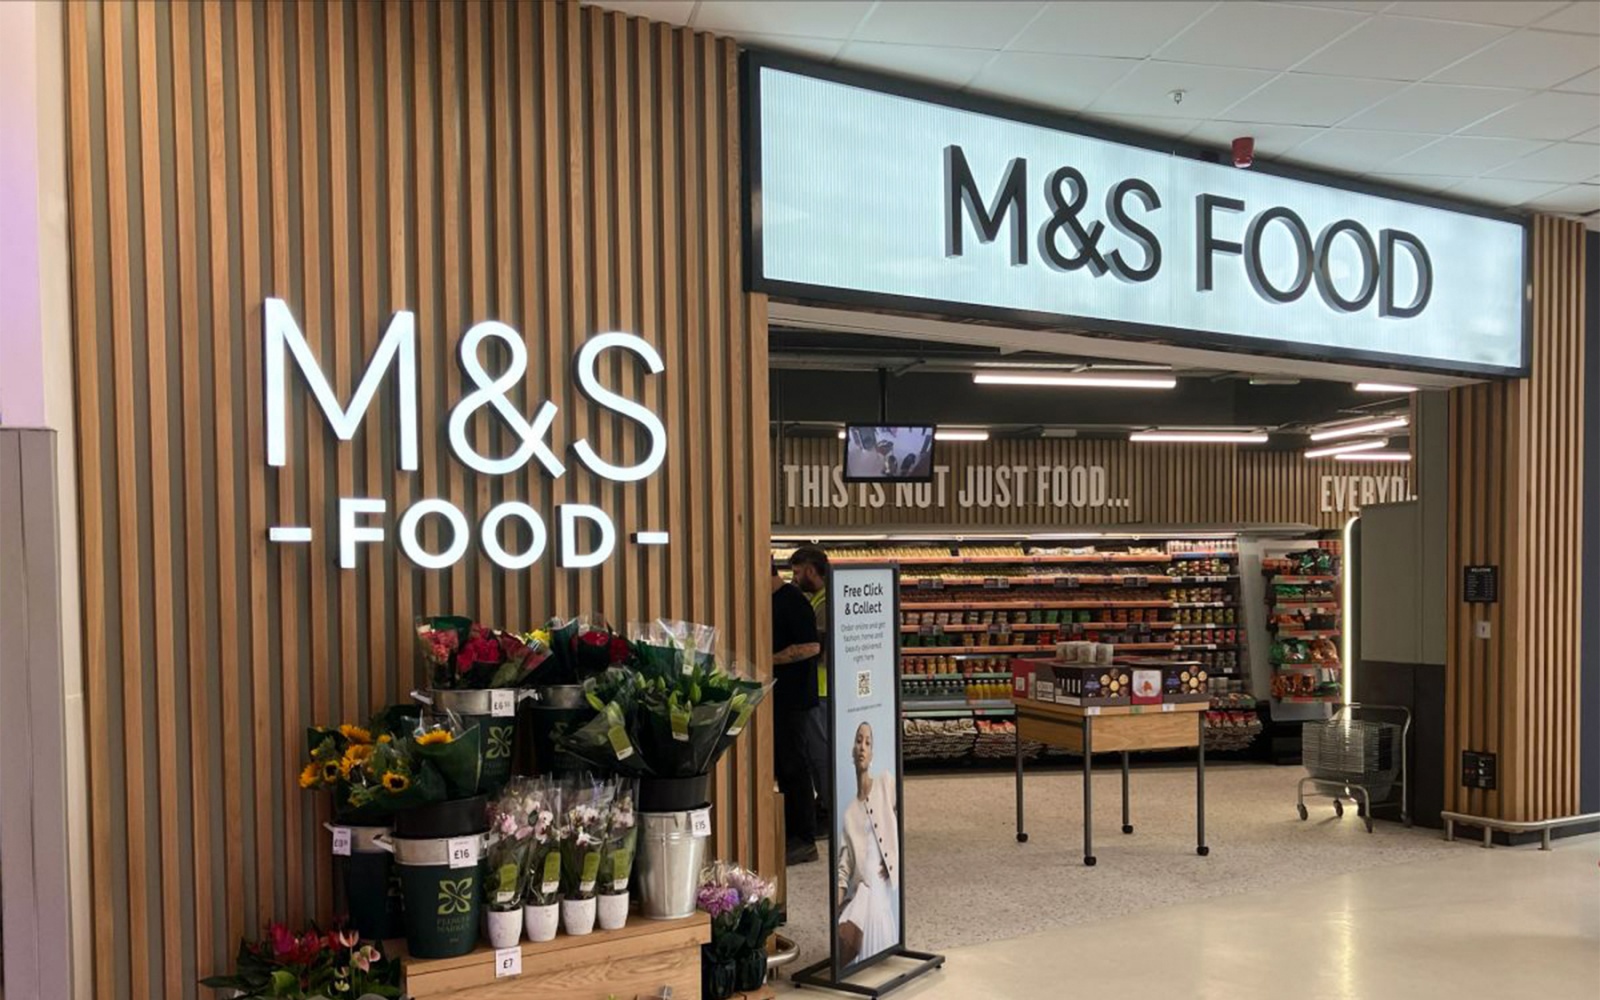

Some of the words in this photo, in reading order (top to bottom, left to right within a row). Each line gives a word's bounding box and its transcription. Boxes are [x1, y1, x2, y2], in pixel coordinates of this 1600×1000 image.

[944, 144, 1162, 283] M&S
[1196, 192, 1433, 319] FOOD
[264, 297, 667, 482] M&S
[783, 464, 849, 508] THIS
[958, 465, 1028, 508] JUST
[843, 584, 862, 598] Free
[863, 582, 884, 597] Click
[844, 602, 852, 616] &
[852, 601, 883, 615] Collect
[454, 848, 470, 860] £16
[503, 957, 514, 969] £7
